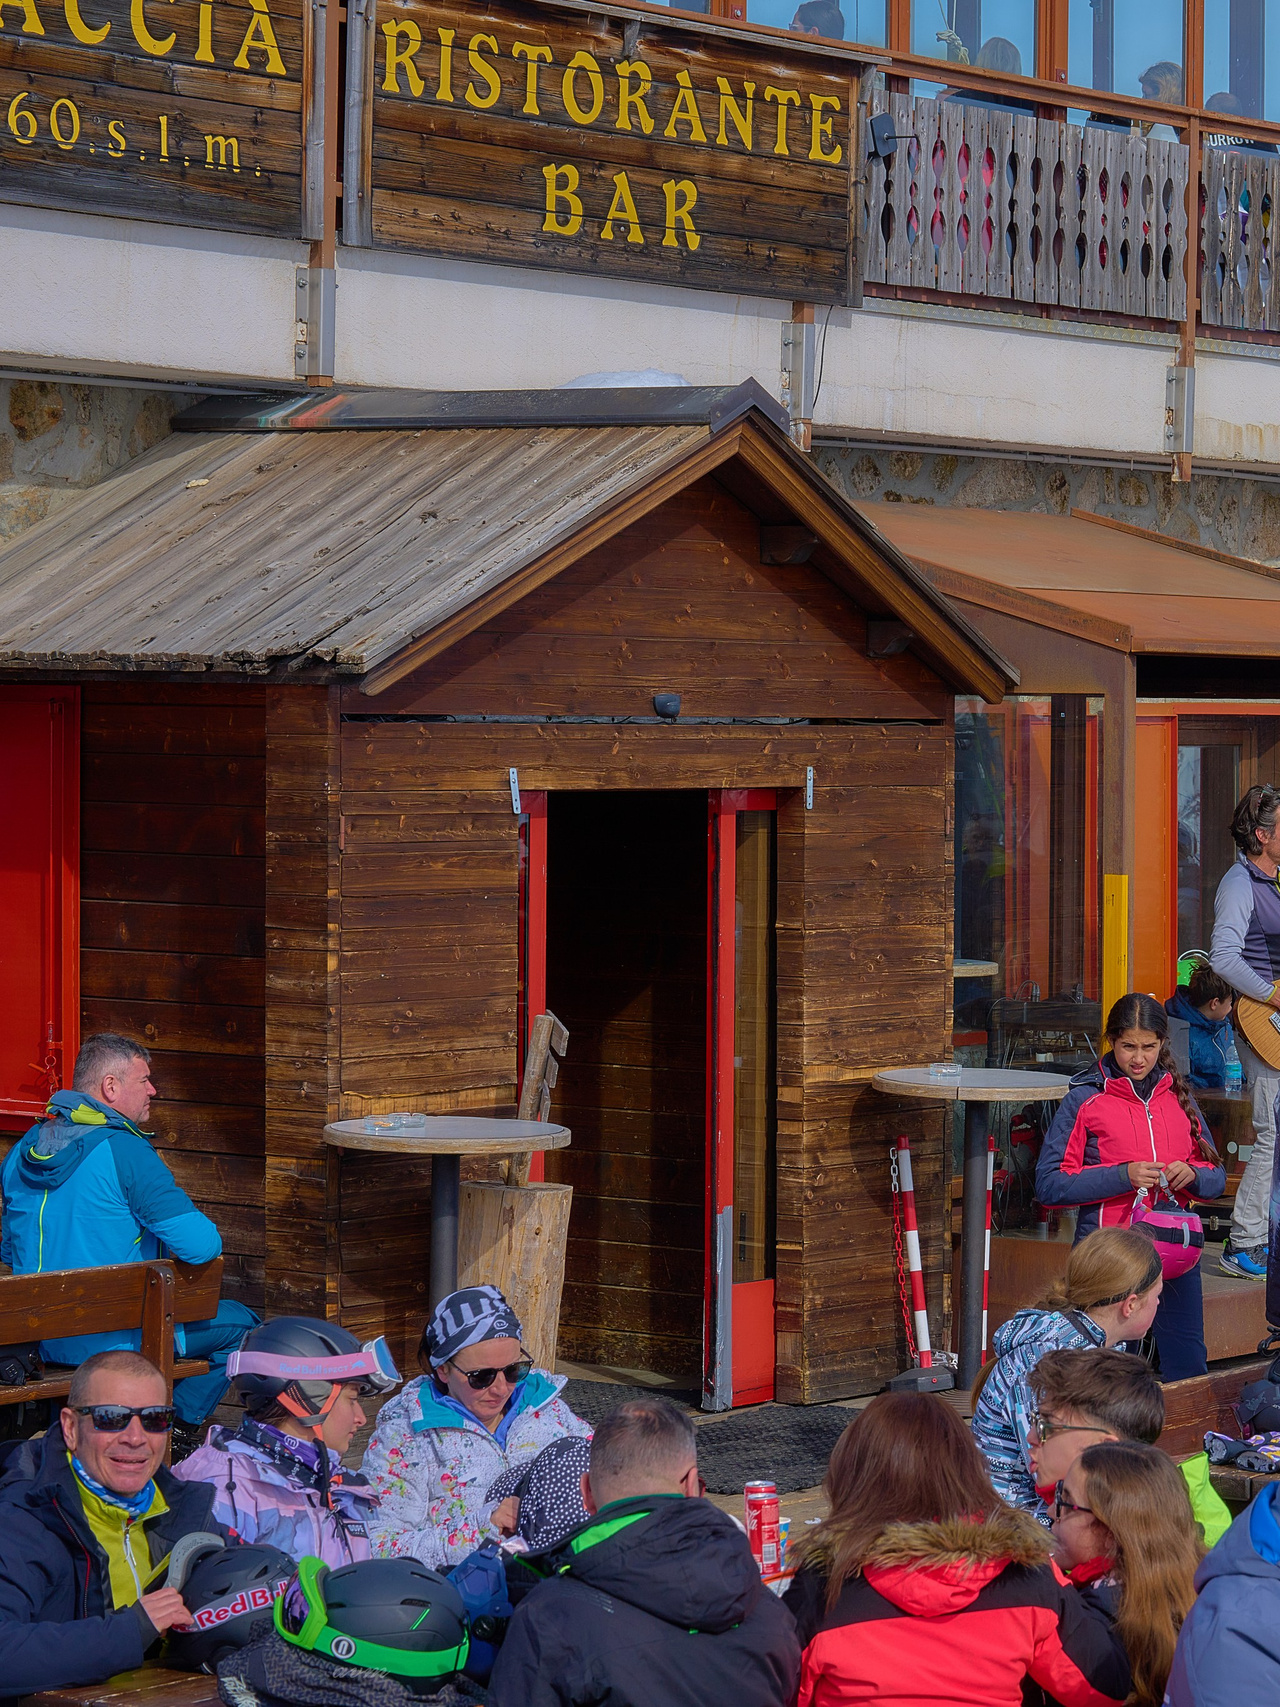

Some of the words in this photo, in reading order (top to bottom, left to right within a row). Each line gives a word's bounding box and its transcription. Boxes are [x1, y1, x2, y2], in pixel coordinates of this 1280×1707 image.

[381, 18, 844, 164] RISTORANTE
[541, 162, 701, 251] BAR
[195, 1591, 248, 1629] Red
